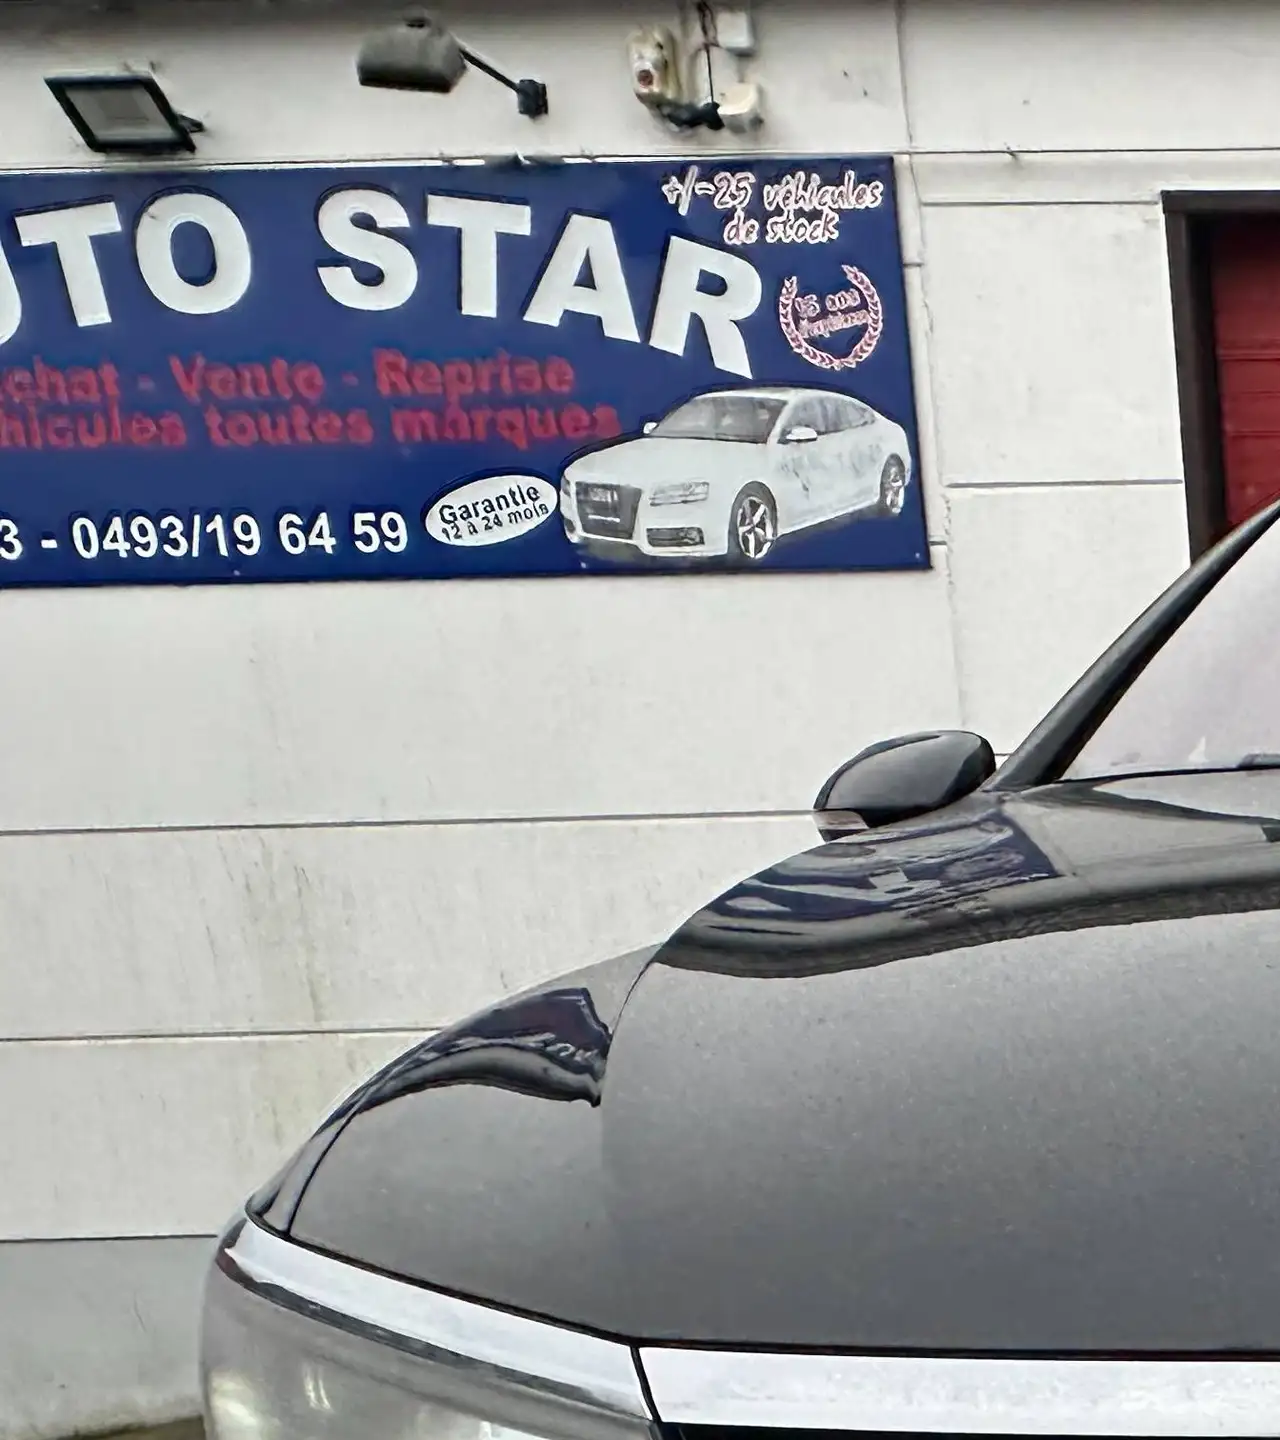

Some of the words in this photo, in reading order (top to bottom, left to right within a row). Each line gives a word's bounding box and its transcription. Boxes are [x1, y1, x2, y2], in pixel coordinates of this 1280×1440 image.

[723, 208, 760, 244] de
[765, 208, 839, 245] stock
[0, 192, 252, 346] TO
[316, 187, 763, 380] STAR
[167, 352, 325, 405] Vente
[372, 346, 576, 408] Reprise
[204, 402, 375, 448] toutes
[390, 402, 622, 451] marques
[438, 485, 541, 525] Garantie
[71, 512, 262, 559] 0493/19
[277, 511, 338, 555] 64
[353, 511, 408, 553] 59
